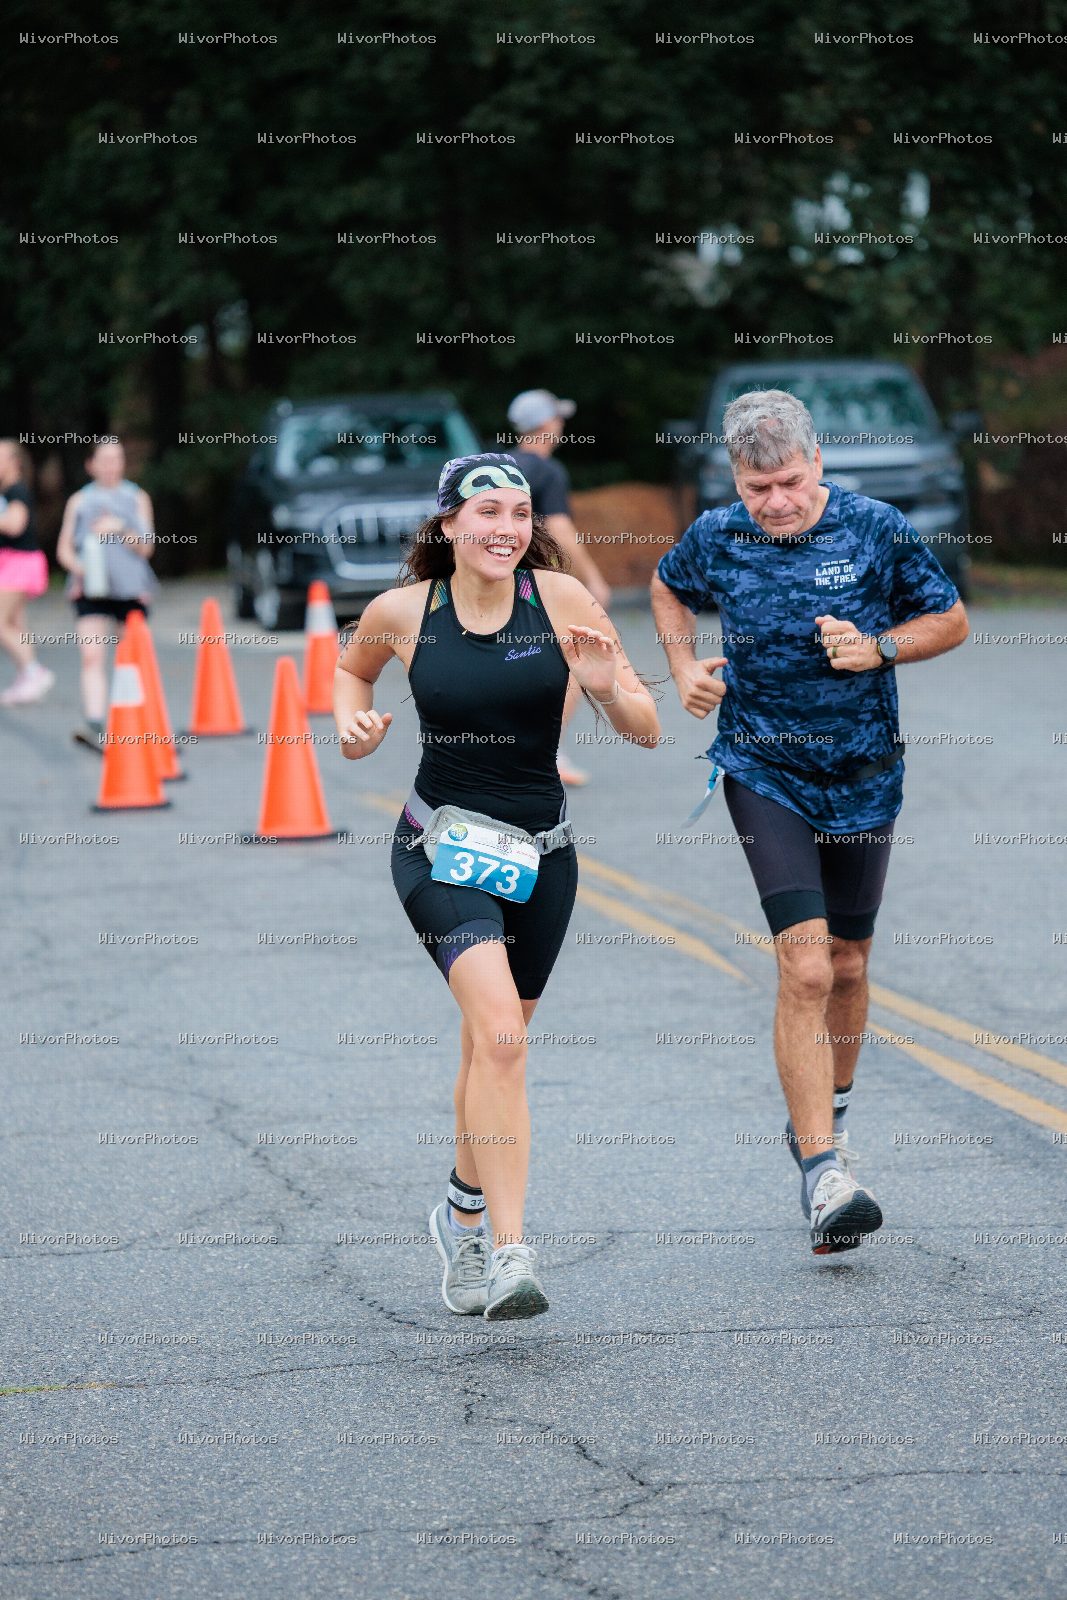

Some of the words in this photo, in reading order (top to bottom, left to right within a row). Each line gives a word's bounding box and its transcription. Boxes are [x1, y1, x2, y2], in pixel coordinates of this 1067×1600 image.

[815, 565, 840, 577] LAND
[843, 563, 854, 573] OF
[814, 576, 831, 586] THE
[833, 573, 857, 584] FREE
[449, 851, 521, 895] 373
